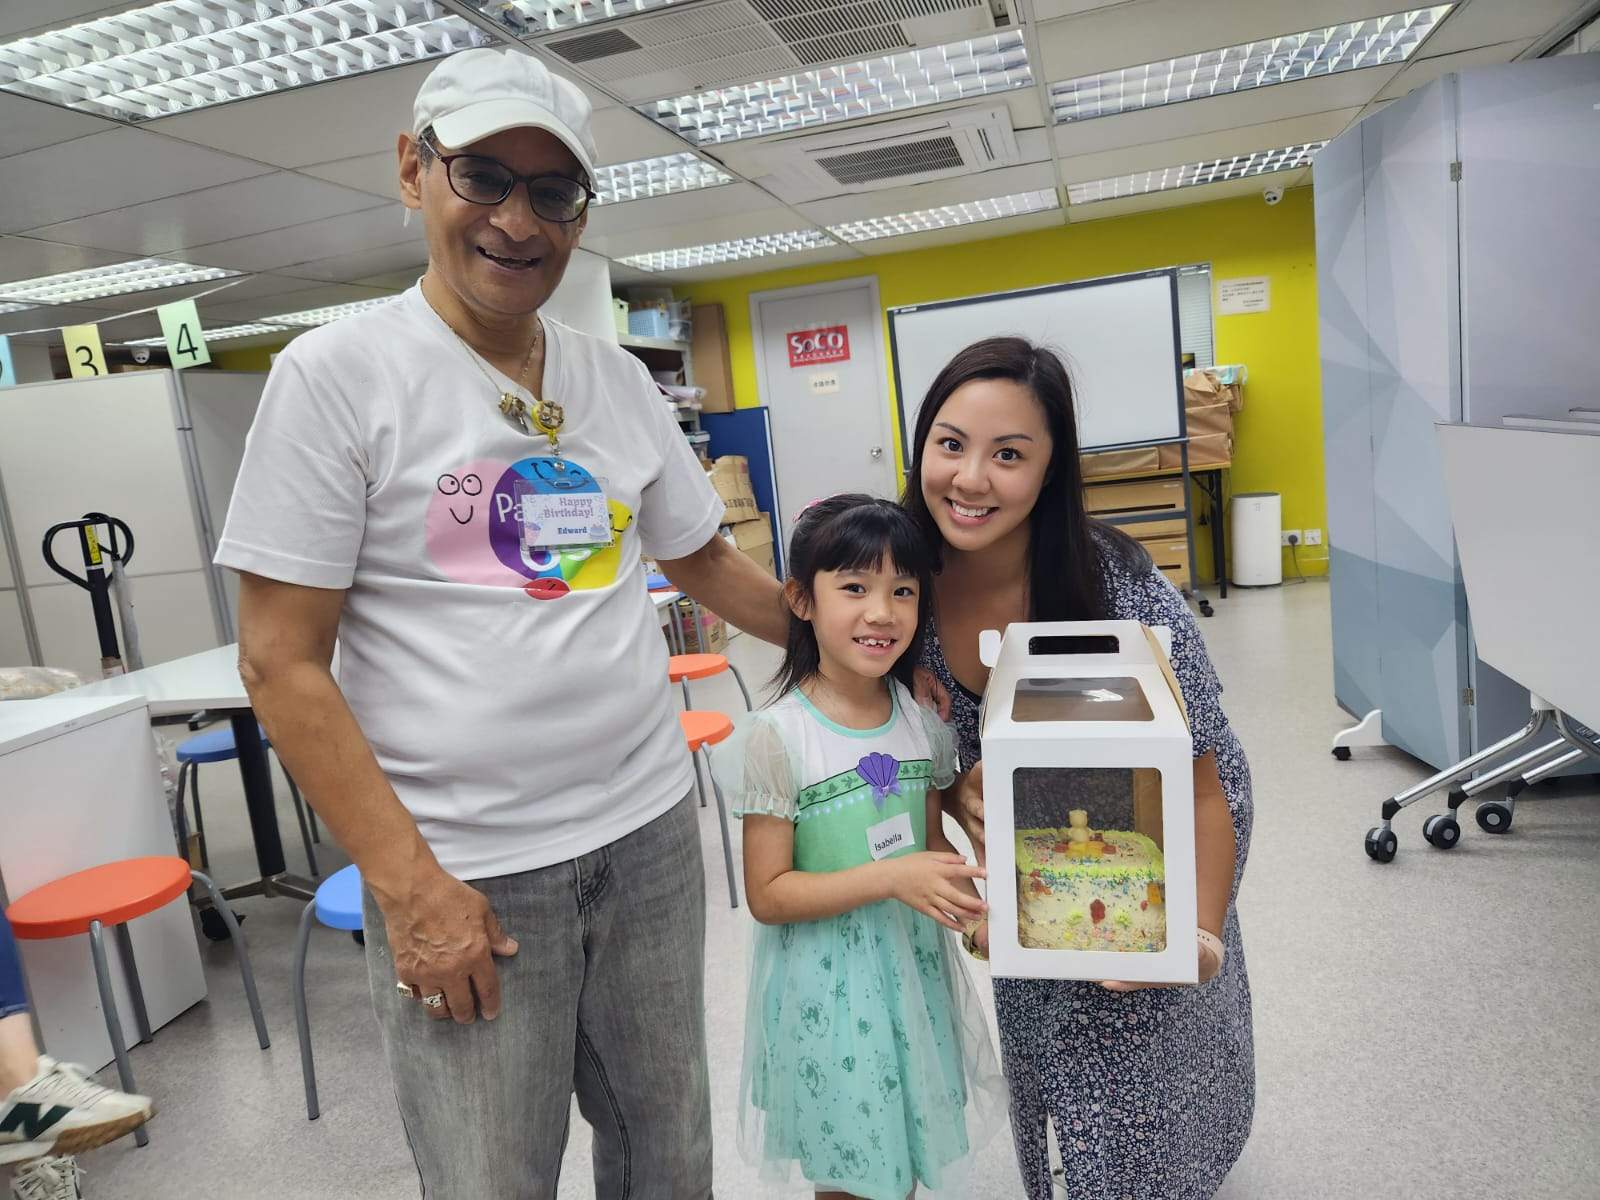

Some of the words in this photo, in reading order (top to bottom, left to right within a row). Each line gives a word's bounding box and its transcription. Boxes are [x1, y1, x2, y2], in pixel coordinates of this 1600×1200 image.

[177, 323, 198, 360] 4
[791, 333, 844, 354] SoCO
[76, 346, 99, 376] 3
[496, 493, 524, 523] Pa
[560, 497, 593, 508] Happy
[544, 507, 594, 519] Birthday!
[557, 526, 588, 535] Edward
[874, 833, 902, 851] Isabella
